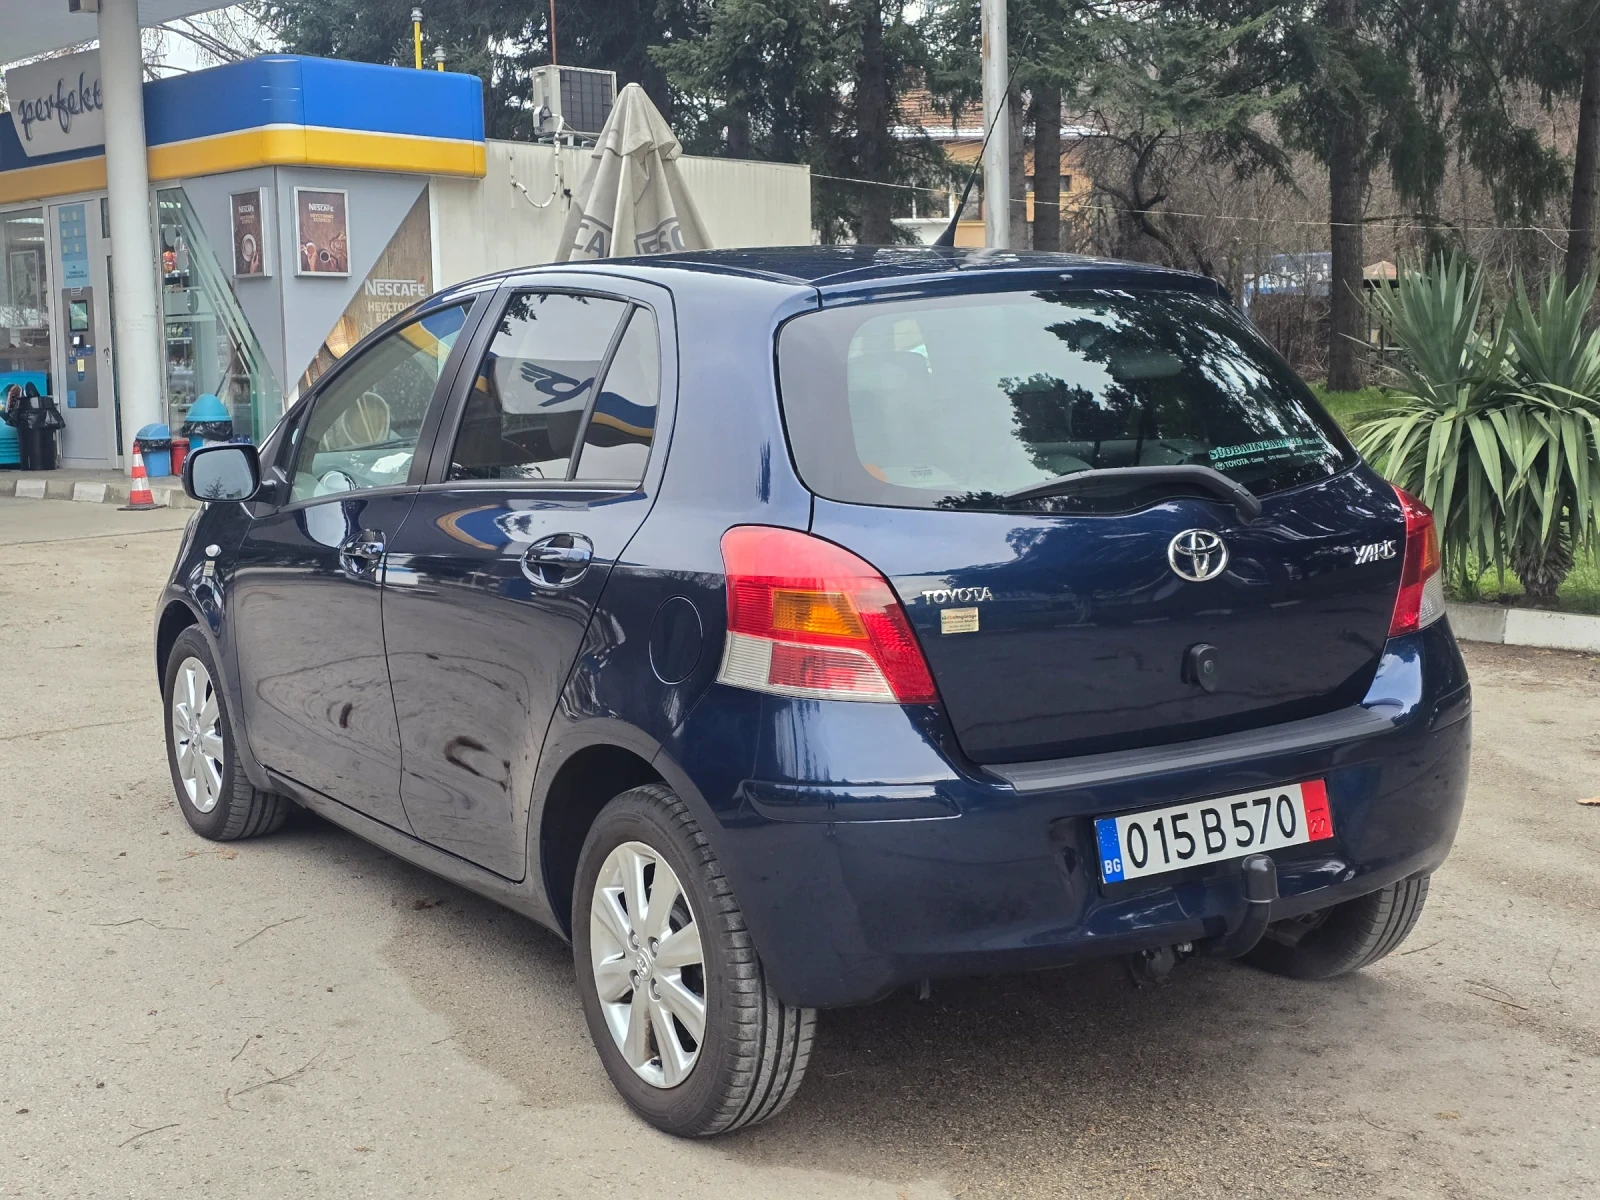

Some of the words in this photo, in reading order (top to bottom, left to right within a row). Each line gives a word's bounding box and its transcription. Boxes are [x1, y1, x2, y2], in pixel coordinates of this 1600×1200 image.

[18, 71, 103, 141] perfekt
[1224, 458, 1249, 468] TOYOTA
[922, 586, 994, 605] TOYOTA
[1104, 859, 1121, 875] BG
